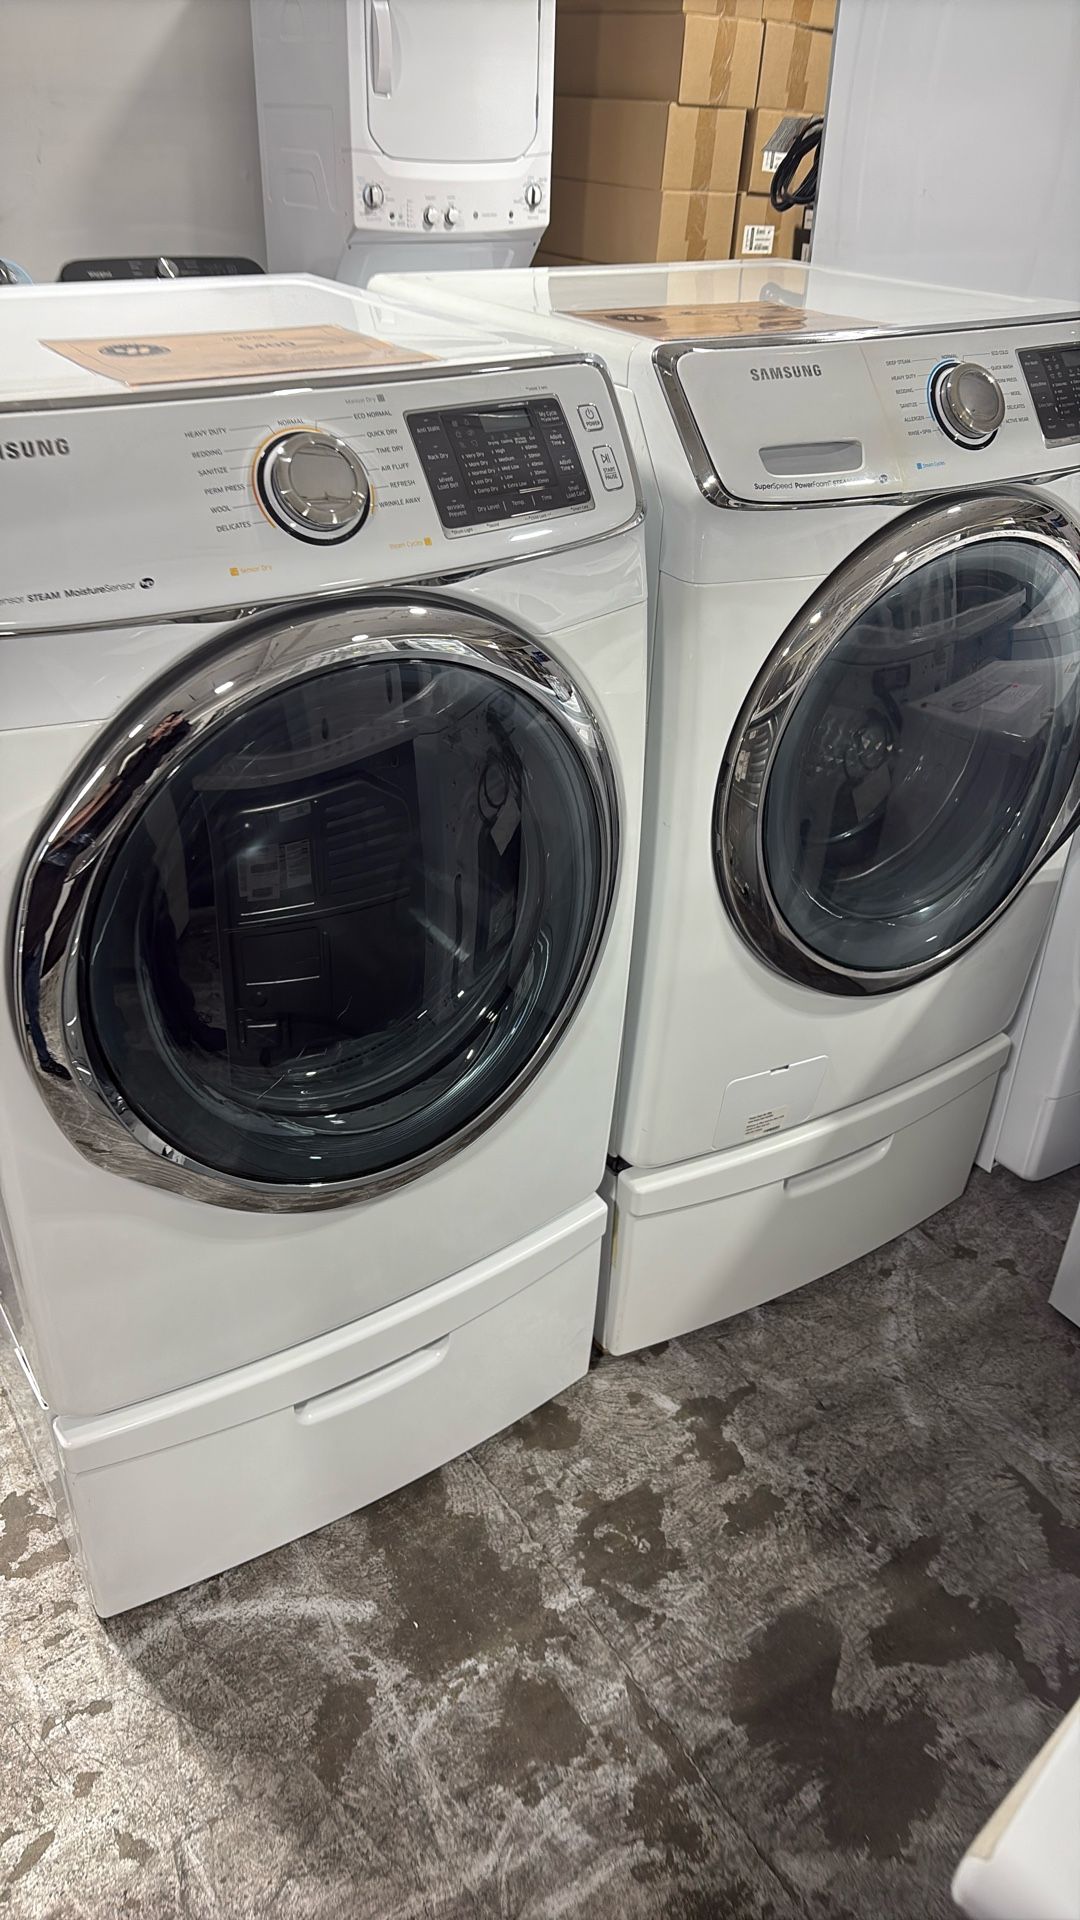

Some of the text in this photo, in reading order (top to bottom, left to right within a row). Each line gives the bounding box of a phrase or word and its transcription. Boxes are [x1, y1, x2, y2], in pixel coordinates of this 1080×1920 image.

[750, 364, 822, 381] SAMSUNG
[353, 410, 392, 420] ECO NORMAL
[184, 427, 227, 439] HEAVY DUTY
[366, 428, 398, 438] QUICK DRY
[191, 449, 223, 459] BEDDING
[376, 446, 390, 454] TIME
[198, 465, 229, 478] SANITIZE
[381, 462, 409, 472] AIR FLUFF
[602, 466, 616, 474] START
[389, 479, 416, 489] REFRESH
[754, 482, 793, 491] SuperSpeed
[204, 483, 246, 497] PERM PRESS
[379, 496, 422, 509] WRINKLE AWAY
[210, 504, 232, 514] WOOL
[215, 520, 253, 533] DELICATES
[26, 591, 61, 602] STEAM
[63, 582, 136, 598] MoistureSensor
